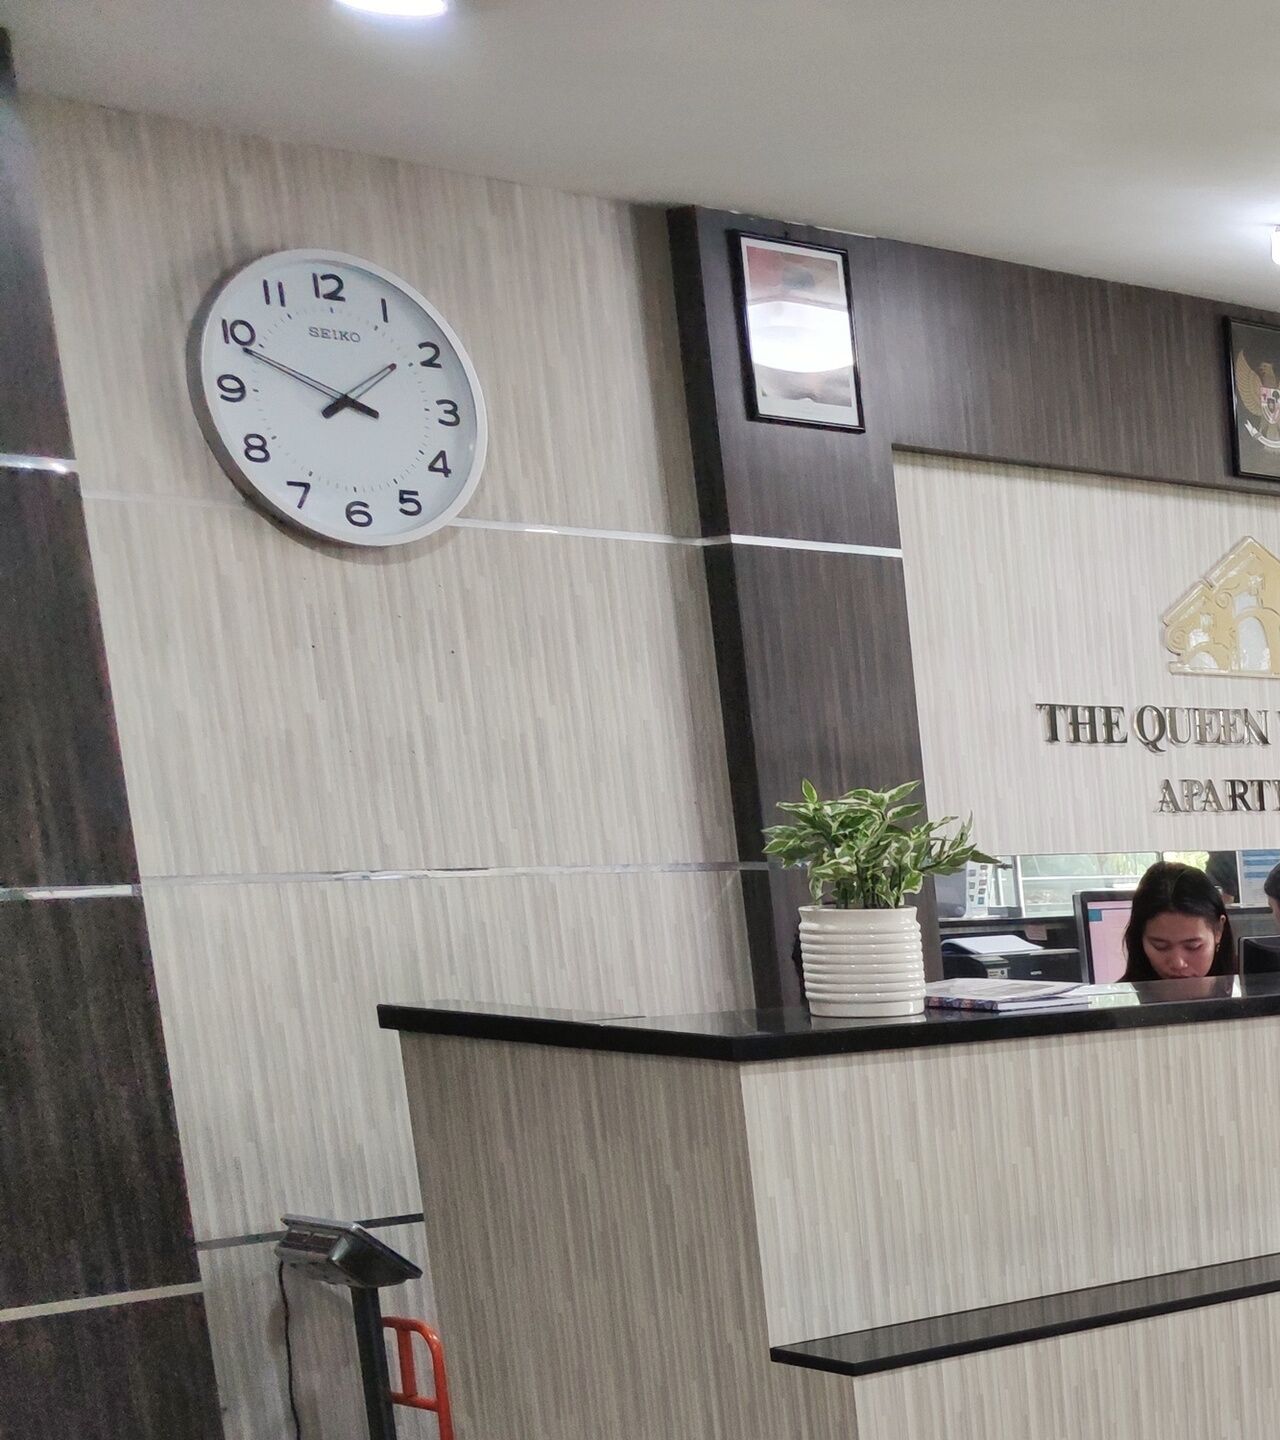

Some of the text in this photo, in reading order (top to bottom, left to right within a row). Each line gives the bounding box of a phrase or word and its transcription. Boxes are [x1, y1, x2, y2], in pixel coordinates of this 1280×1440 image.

[263, 279, 286, 307] 11
[312, 272, 346, 302] 12
[380, 297, 389, 324] 1
[221, 318, 256, 347] 10
[308, 326, 361, 343] SEIKO
[417, 341, 443, 369] 2
[216, 373, 246, 402] 9
[435, 399, 461, 427] 3
[243, 433, 271, 463] 8
[427, 450, 452, 478] 4
[286, 480, 311, 509] 7
[398, 489, 423, 517] 5
[345, 500, 373, 528] 6
[1035, 702, 1129, 746] THE
[1133, 704, 1271, 754] QUEEN
